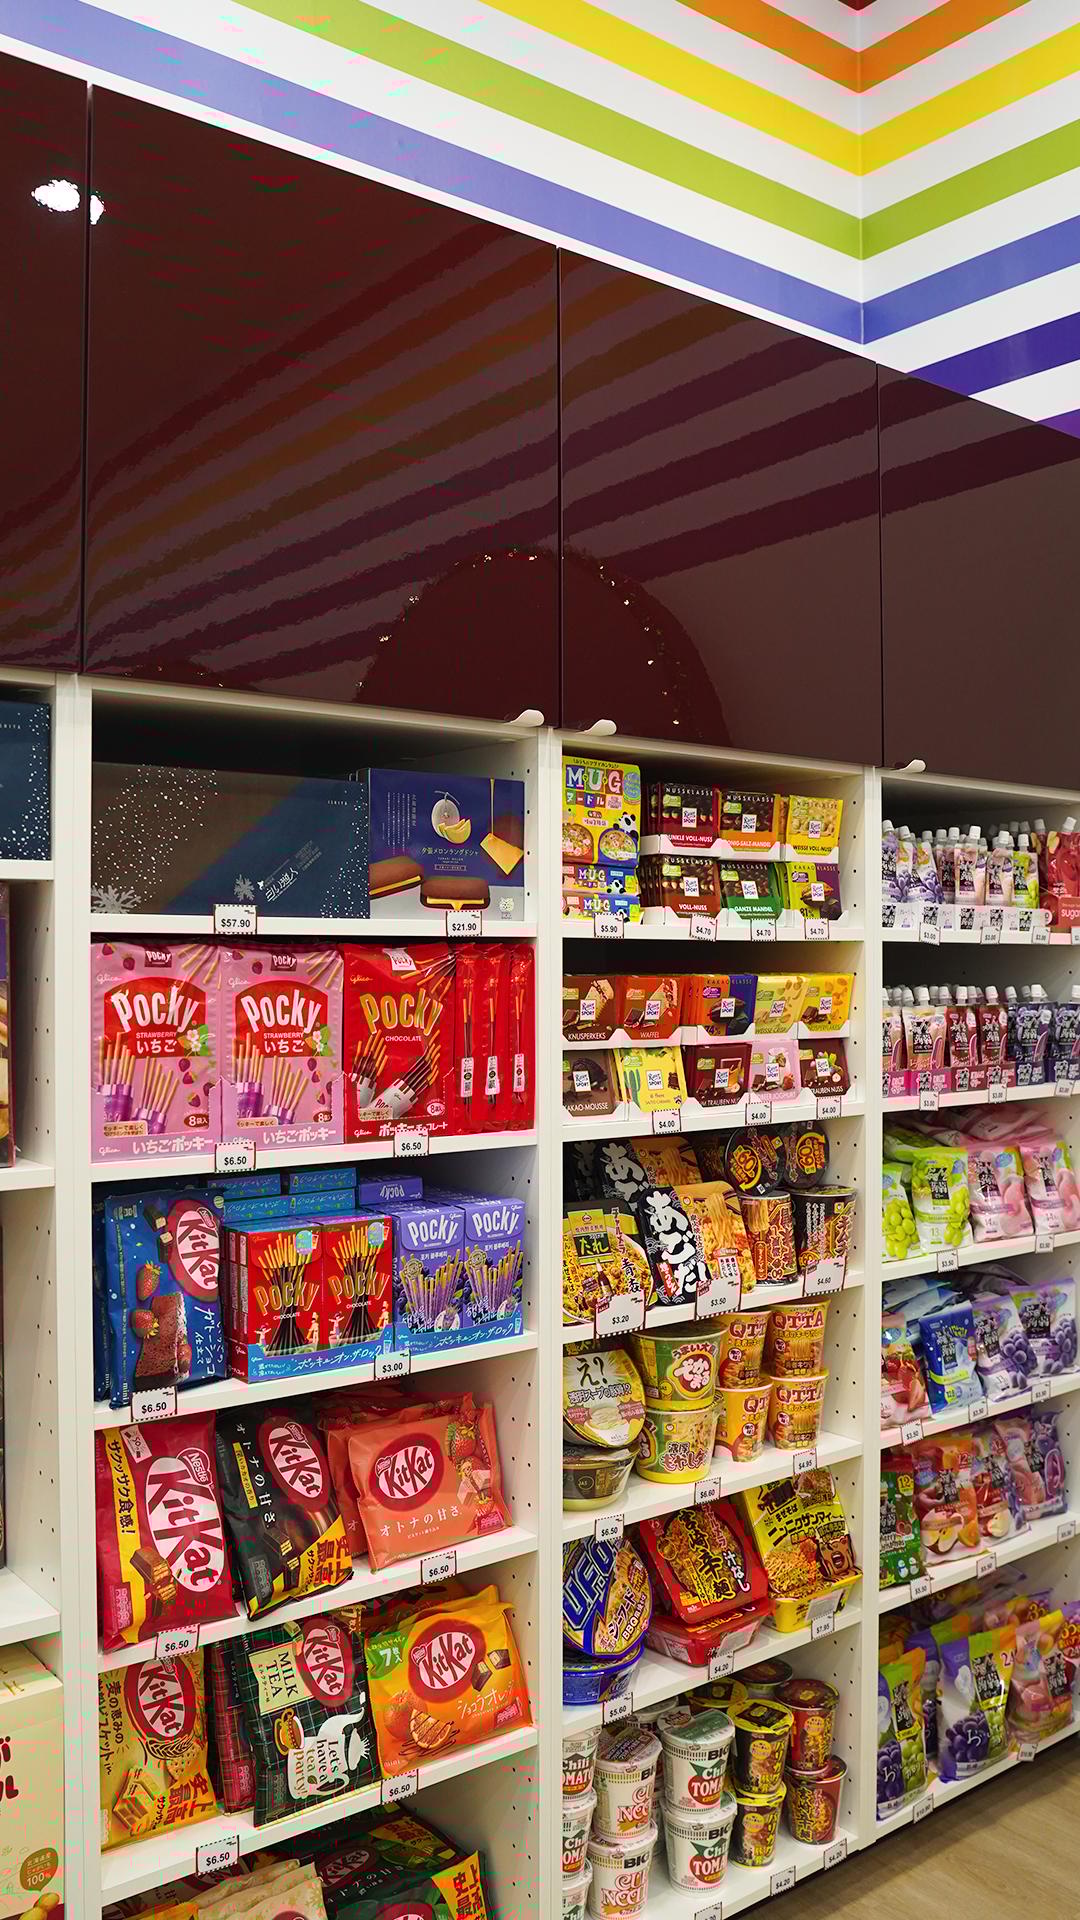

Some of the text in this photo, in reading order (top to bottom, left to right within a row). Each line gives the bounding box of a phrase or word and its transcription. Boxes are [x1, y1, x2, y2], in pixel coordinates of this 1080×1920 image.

[679, 903, 708, 912] VOLL-NUSS
[220, 918, 251, 928] $57.90
[451, 922, 477, 931] $21.90
[600, 925, 618, 934] $5.90
[696, 926, 712, 936] $4.70
[756, 928, 771, 936] $4.70
[810, 927, 824, 936] $4.70
[136, 1039, 178, 1054] いちご
[264, 1039, 305, 1054] いちご
[751, 1112, 767, 1120] $4.00
[822, 1106, 836, 1114] $4.00
[658, 1120, 676, 1129] $4.00
[262, 1127, 337, 1145] いちごポッキー
[132, 1134, 214, 1155] いちごポッキー
[400, 1141, 422, 1151] $6.50
[223, 1156, 247, 1166] $6.50
[580, 1237, 609, 1256] たれ
[710, 1297, 727, 1308] $3.50
[612, 1314, 630, 1325] $3.20
[382, 1362, 403, 1373] $3.00
[141, 1401, 168, 1415] $6.50
[188, 1451, 209, 1484] Nestlé
[269, 1434, 322, 1496] KitKat
[798, 1460, 813, 1470] $4.95
[235, 1423, 277, 1530] オトナの甘さ
[383, 1446, 436, 1499] KitKat
[700, 1488, 716, 1498] $6.60
[379, 1505, 463, 1537] オトナの甘さ
[146, 1470, 225, 1588] KitKat
[601, 1527, 618, 1537] $6.50
[428, 1564, 450, 1577] $6.50
[816, 1623, 830, 1634] $7.95
[164, 1639, 190, 1652] $6.50
[304, 1636, 344, 1696] KitKat
[419, 1636, 477, 1688] KitKat
[713, 1662, 729, 1674] $4.20
[277, 1650, 299, 1698] MILK
[264, 1663, 283, 1699] TEA
[139, 1664, 185, 1736] KitKat
[105, 1680, 124, 1745] 麦の恵みの
[609, 1705, 627, 1716] $5.60
[305, 1748, 315, 1774] tea
[315, 1738, 328, 1773] have
[327, 1738, 339, 1774] Let's
[293, 1750, 309, 1797] party!
[389, 1783, 412, 1797] $6.50
[205, 1850, 231, 1867] $6.50
[828, 1850, 842, 1863] $4.20
[775, 1877, 791, 1890] $4.20
